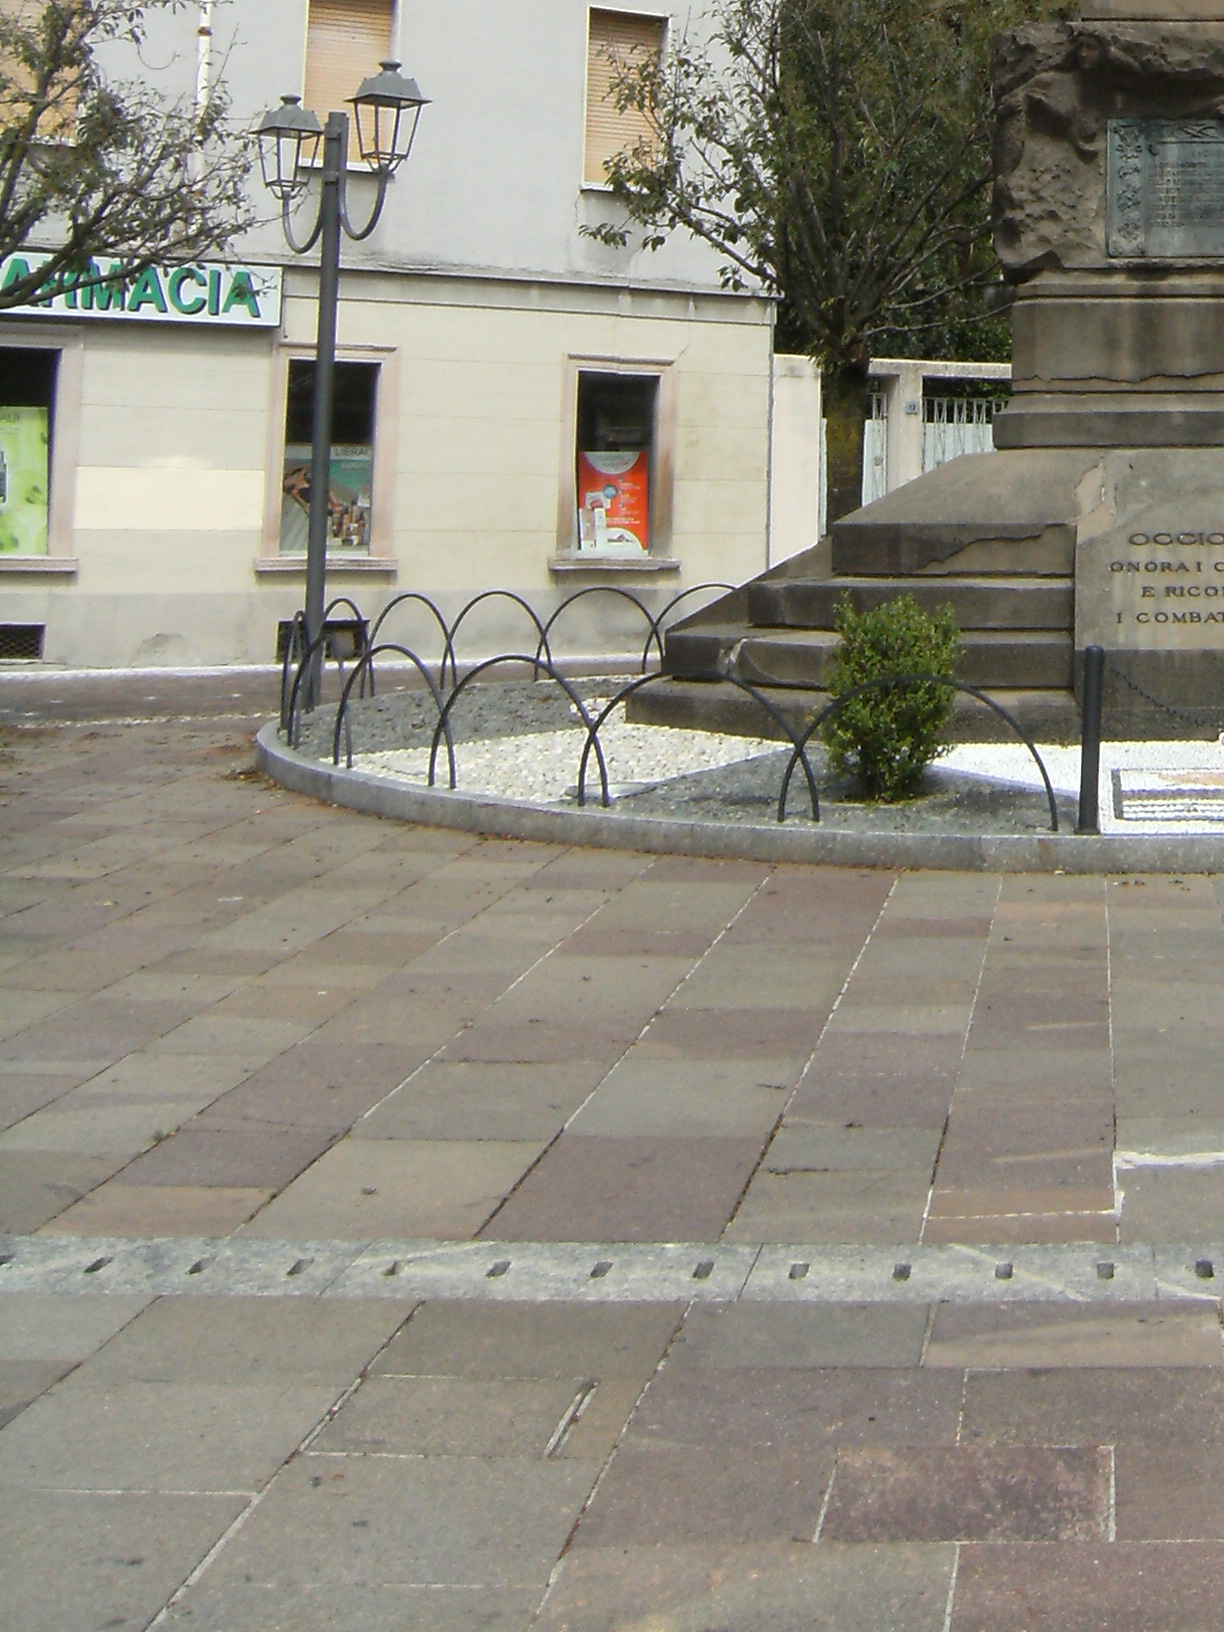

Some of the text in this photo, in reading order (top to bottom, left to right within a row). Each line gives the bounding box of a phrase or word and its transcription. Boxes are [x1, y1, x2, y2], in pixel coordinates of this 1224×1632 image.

[0, 255, 261, 317] ARMACIA
[1110, 561, 1190, 573] ONORA
[1196, 561, 1203, 573] I
[1141, 586, 1155, 598] E
[1116, 611, 1123, 624] I
